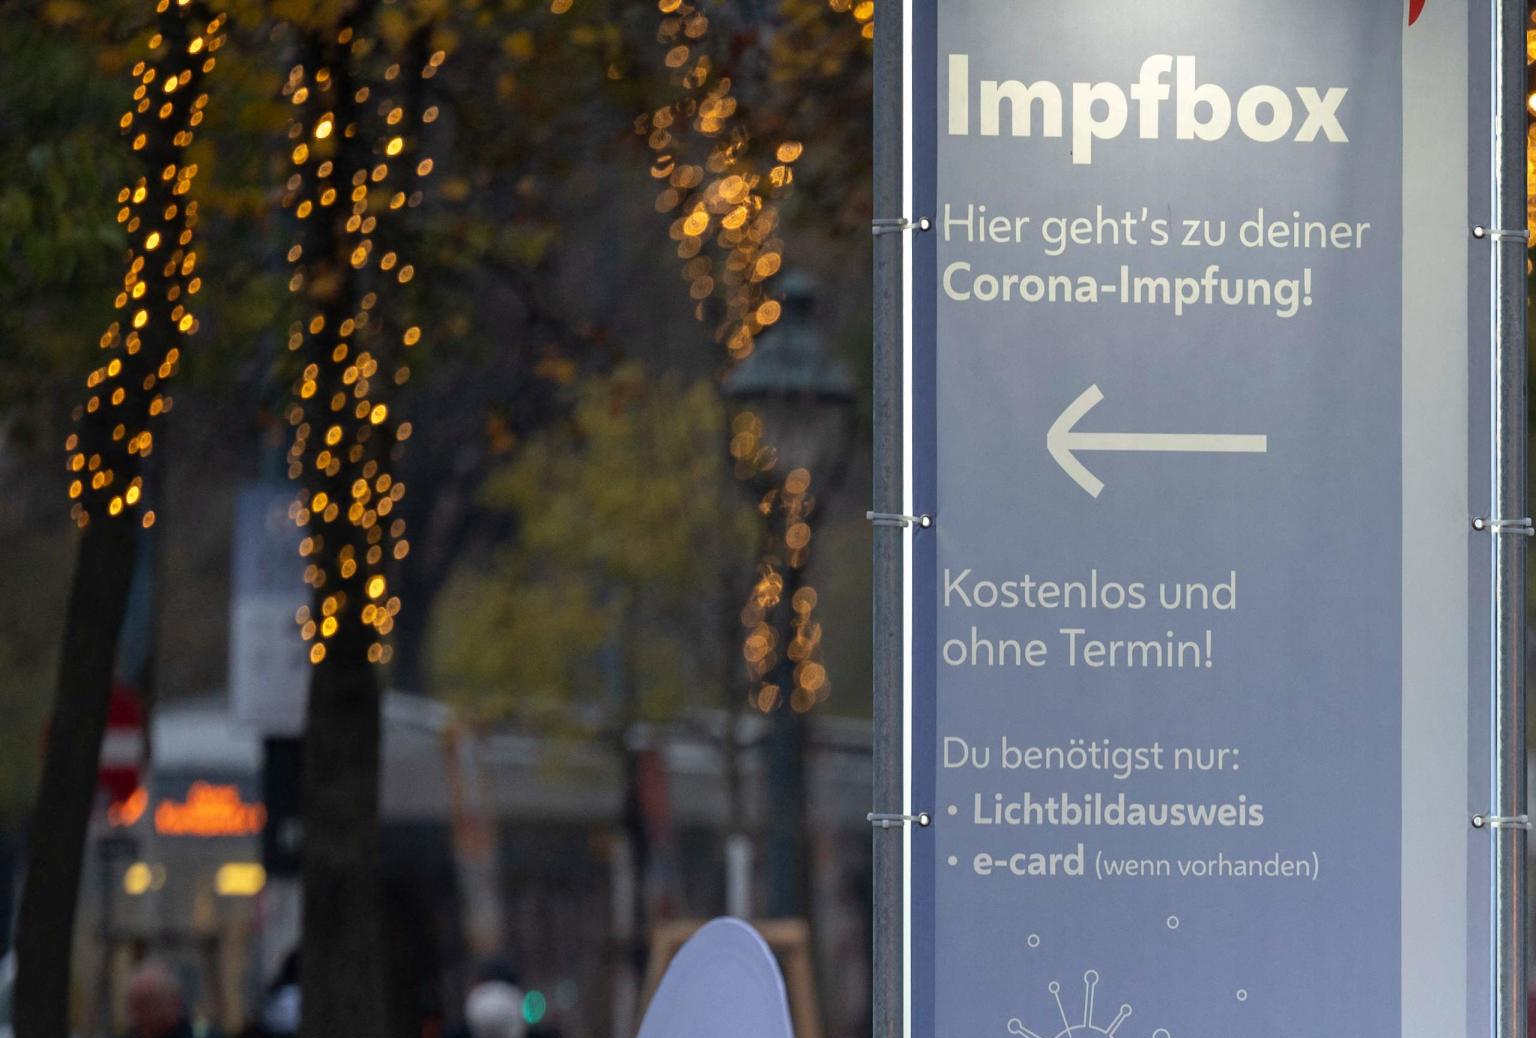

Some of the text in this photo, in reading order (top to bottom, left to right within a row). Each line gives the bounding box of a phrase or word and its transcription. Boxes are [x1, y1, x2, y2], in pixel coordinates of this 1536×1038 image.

[949, 54, 1349, 164] Impfbox
[944, 204, 1370, 255] Hier geht’s zu deiner
[944, 262, 1312, 317] Corona-Impfung!
[945, 569, 1235, 609] Kostenlos und
[944, 626, 1212, 667] ohne Termin!
[944, 736, 1238, 779] Du benötigst nur:
[975, 793, 1264, 826] Lichtbildausweis
[974, 844, 1318, 880] e-card (wenn vorhanden)
